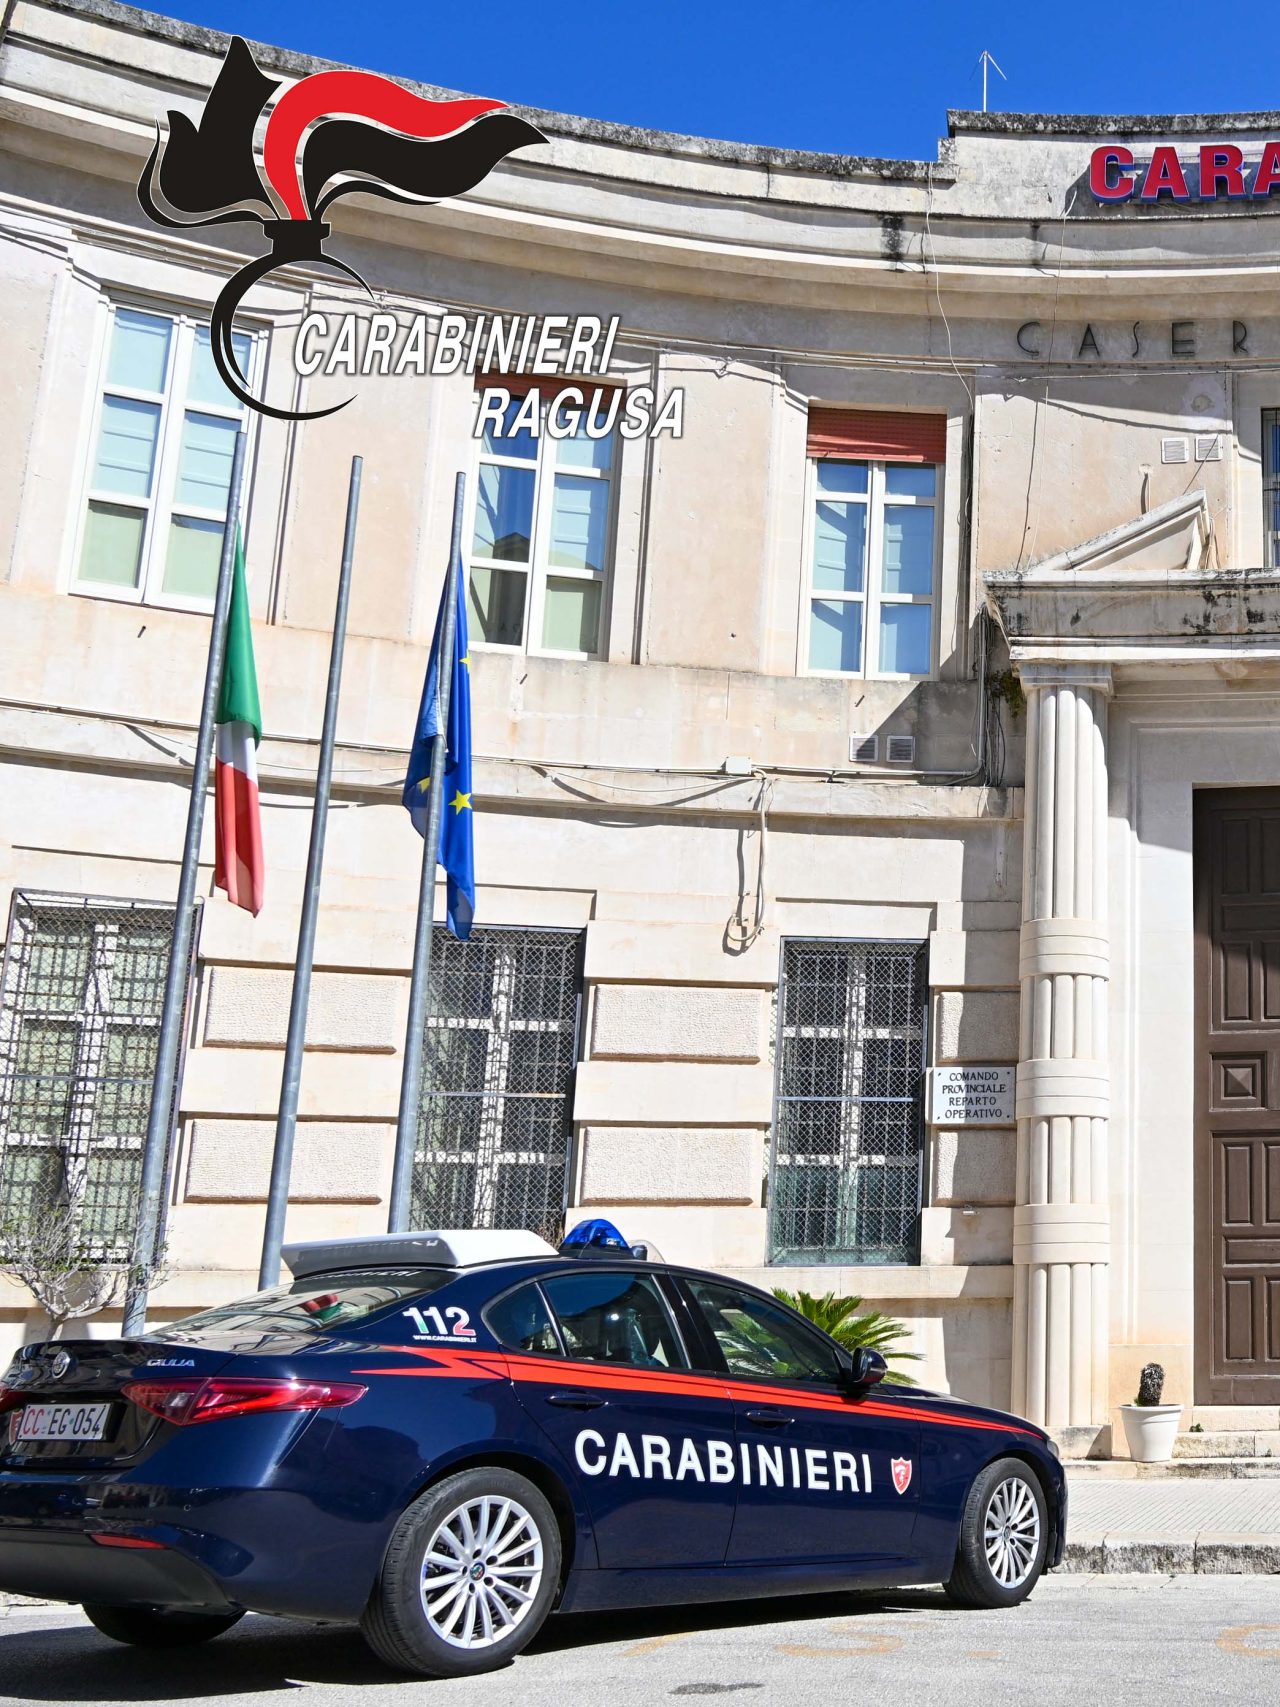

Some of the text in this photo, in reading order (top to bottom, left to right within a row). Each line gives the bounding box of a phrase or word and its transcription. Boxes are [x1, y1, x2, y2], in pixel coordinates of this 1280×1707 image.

[949, 1071, 998, 1081] COMANDO
[942, 1084, 1006, 1094] PROVINCIALE
[949, 1097, 997, 1106] REPARTO
[945, 1108, 1002, 1119] OPERATIVO
[402, 1306, 477, 1336] 112
[147, 1358, 195, 1367] GIULIA
[22, 1408, 45, 1436] CC
[47, 1407, 71, 1436] EG
[574, 1429, 872, 1493] CARABINIERI
